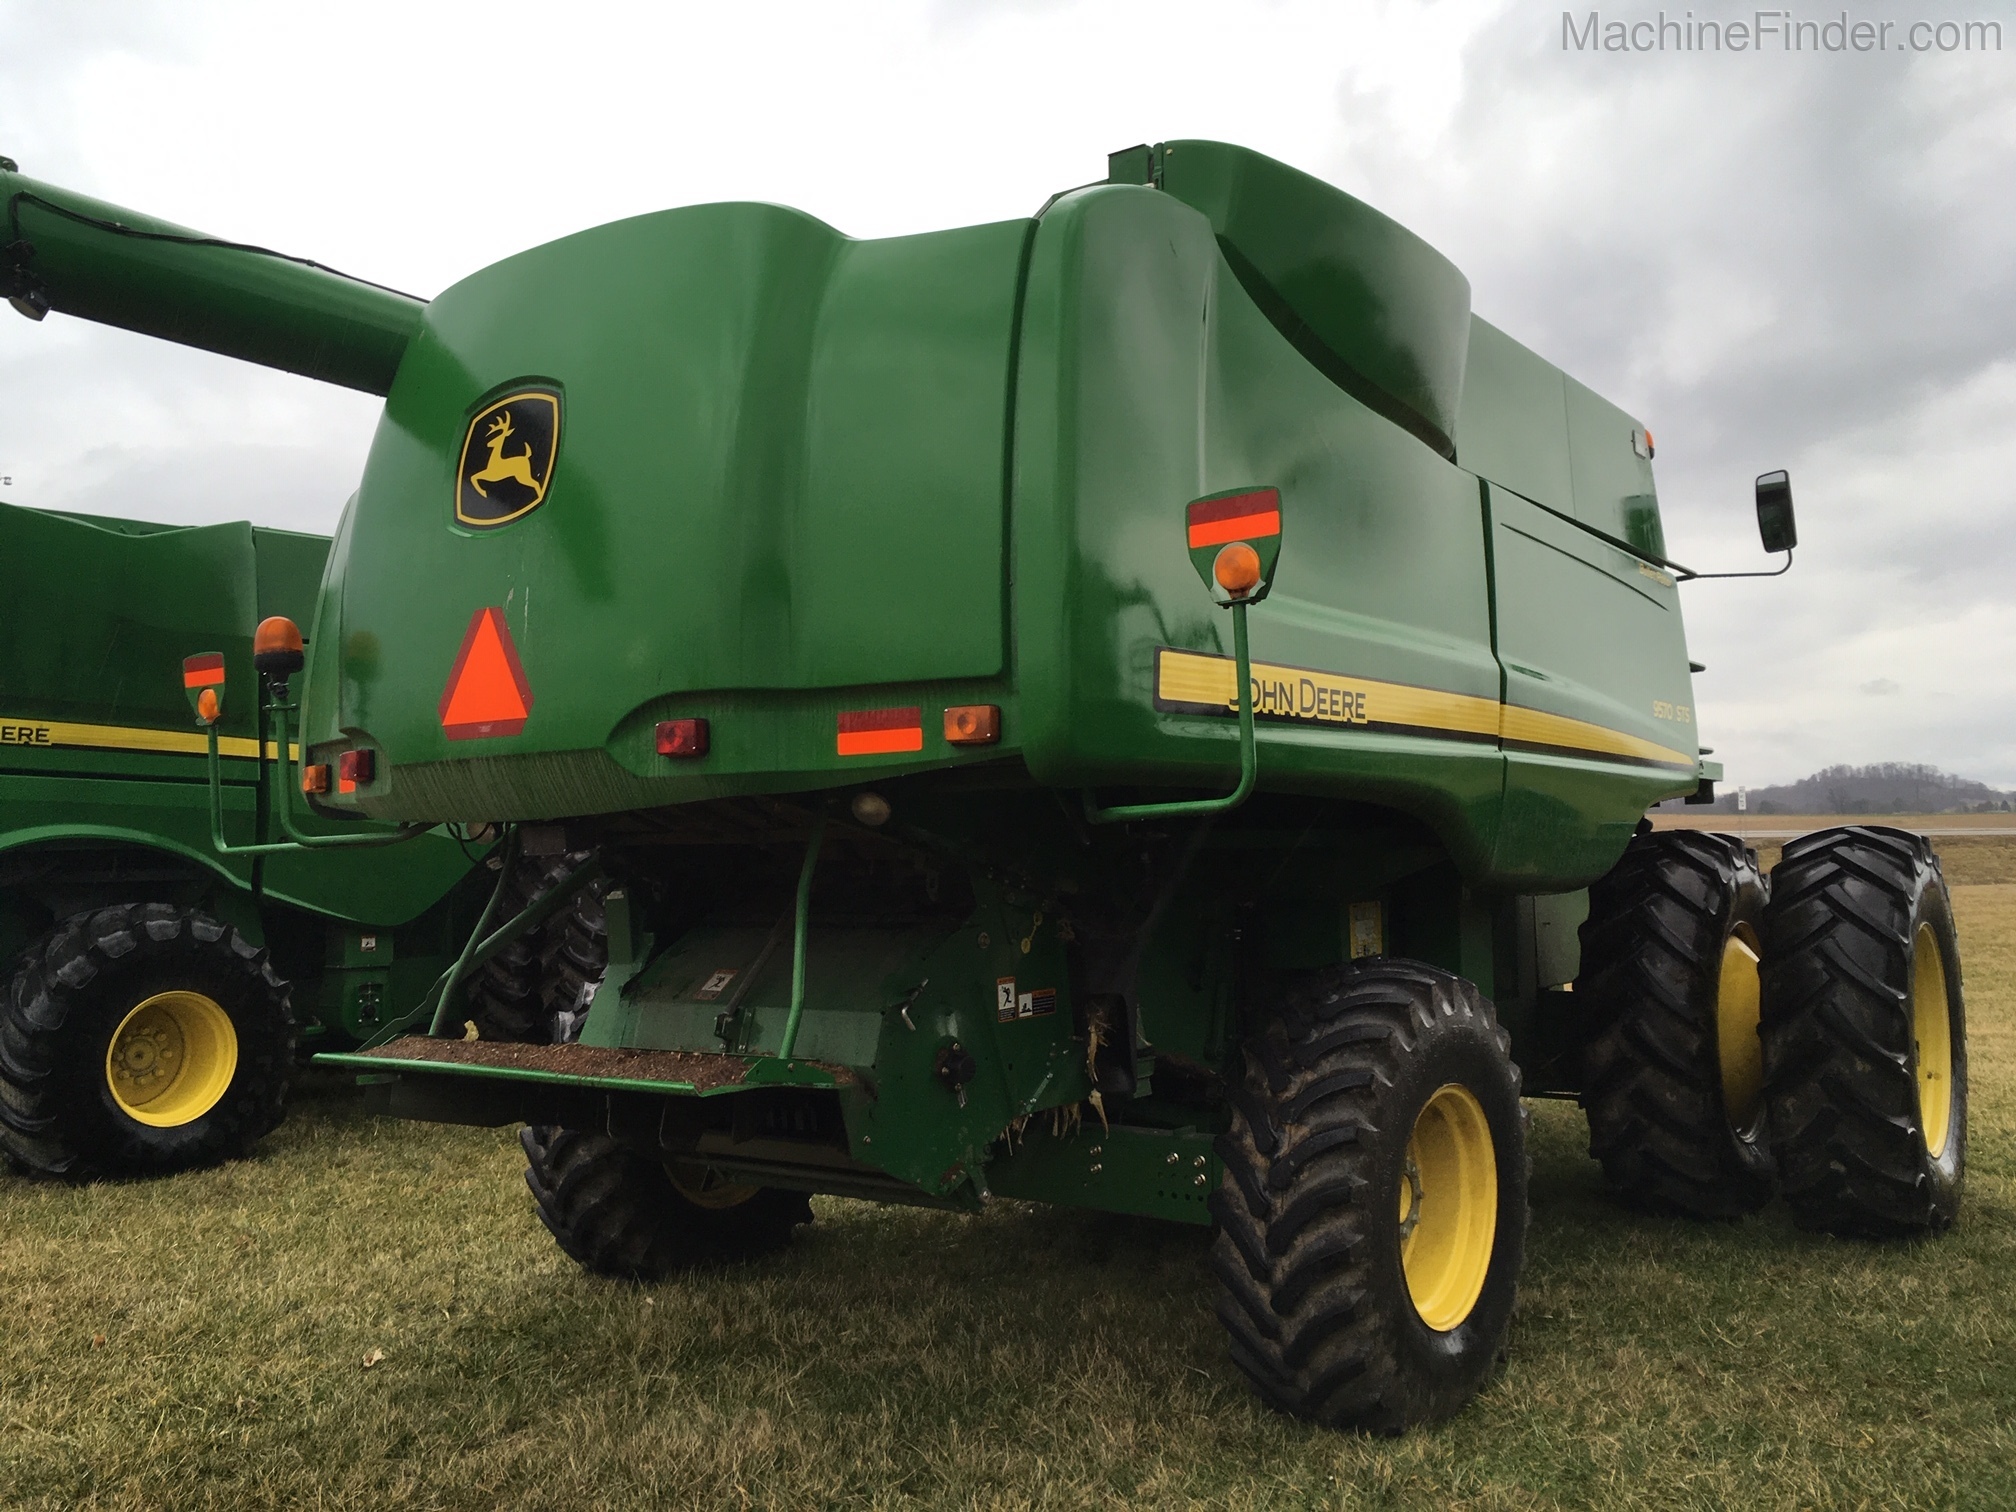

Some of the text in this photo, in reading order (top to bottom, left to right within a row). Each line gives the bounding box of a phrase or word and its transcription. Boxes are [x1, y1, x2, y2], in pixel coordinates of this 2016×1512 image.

[1299, 677, 1367, 720] DEERE
[1653, 699, 1691, 724] 9570 STS
